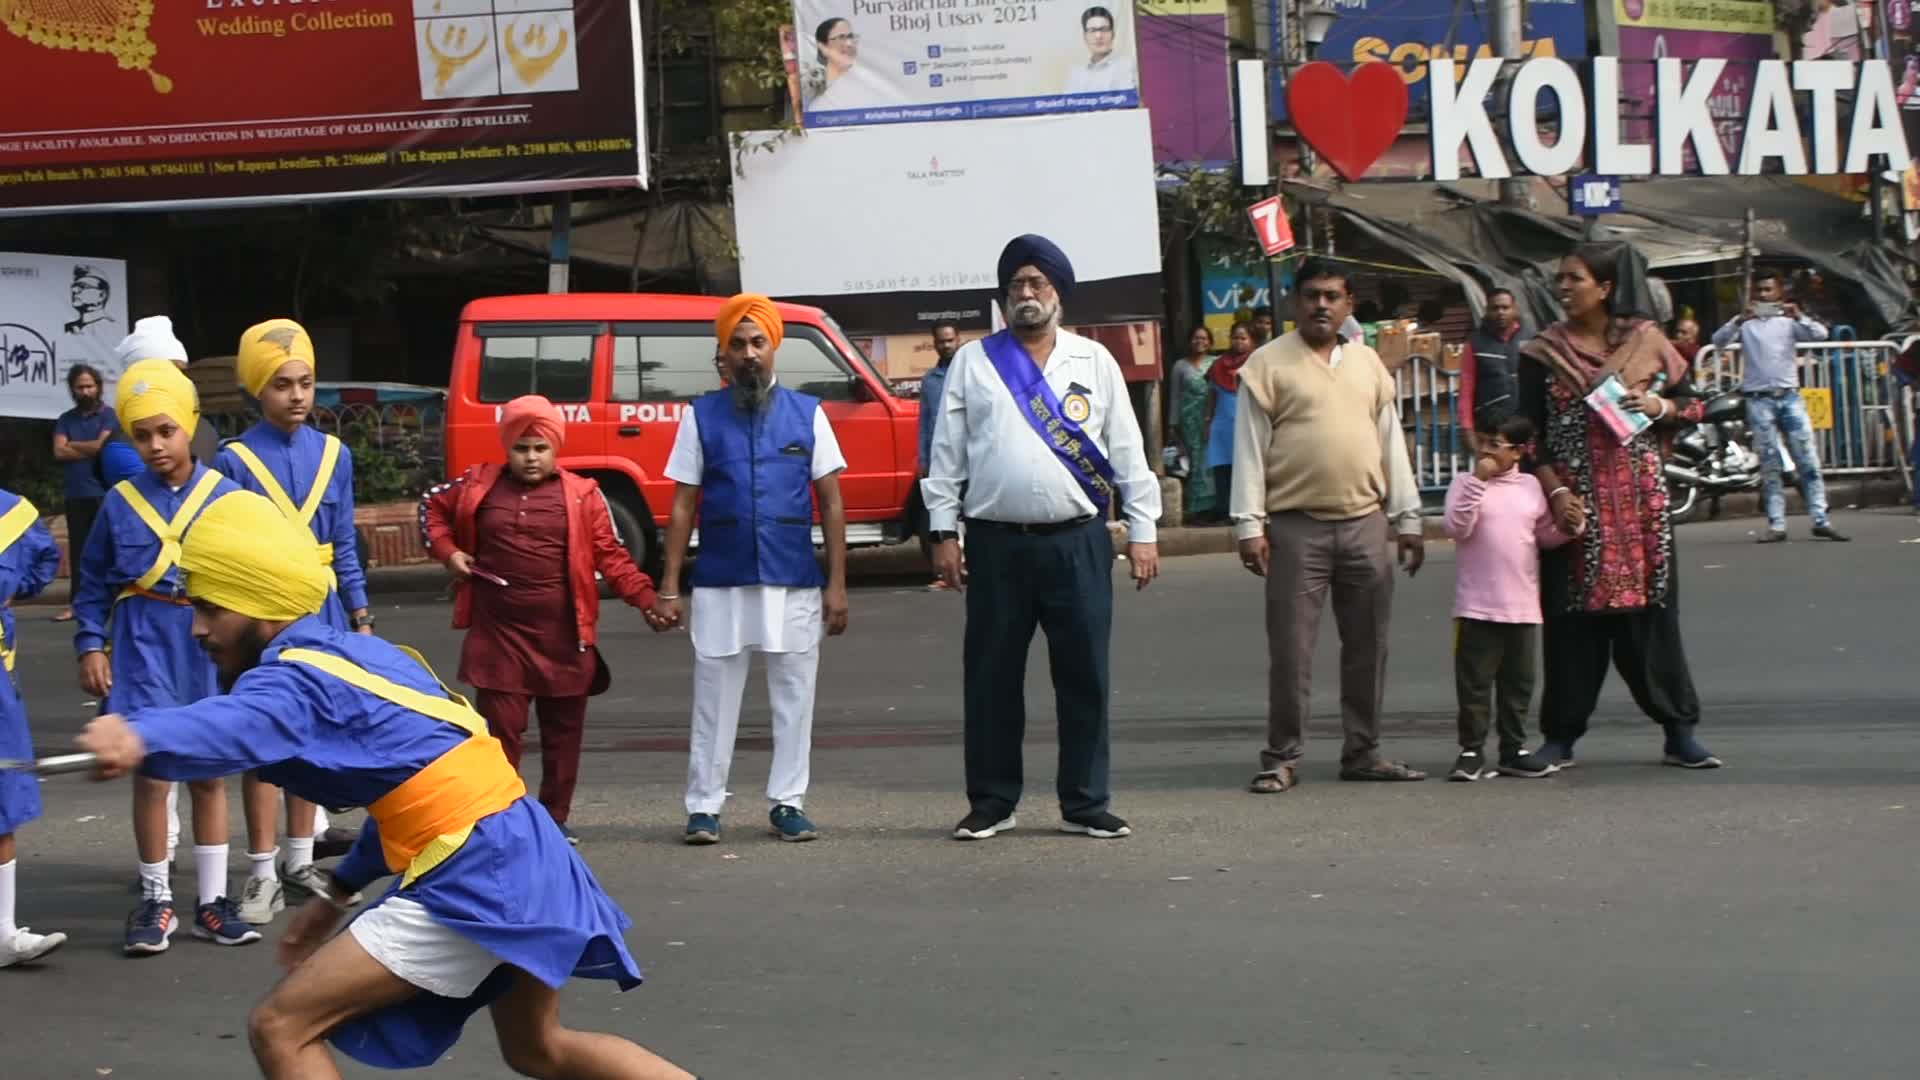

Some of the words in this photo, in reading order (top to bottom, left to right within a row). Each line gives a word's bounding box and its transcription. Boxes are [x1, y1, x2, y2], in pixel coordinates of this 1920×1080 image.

[197, 16, 286, 37] Wedding
[291, 9, 394, 32] Collection
[890, 14, 931, 32] Bhoj
[938, 10, 986, 28] Utsav
[936, 106, 963, 117] Singh
[1100, 94, 1127, 105] Singh
[24, 139, 77, 150] FACILITY
[79, 135, 144, 148] AVAILABLE.
[149, 135, 167, 145] NO
[169, 129, 238, 144] DEDUCTION
[241, 129, 255, 140] IN
[256, 126, 328, 138] WEIGHTAGE
[329, 124, 344, 135] OF
[349, 122, 373, 134] OLD
[375, 117, 459, 132] HALLMARKED
[461, 113, 532, 127] JEWELLERY.
[1237, 59, 1269, 185] I
[1430, 57, 1911, 181] KOLKATA
[214, 161, 235, 173] New
[399, 151, 417, 163] The
[1252, 203, 1281, 245] 7
